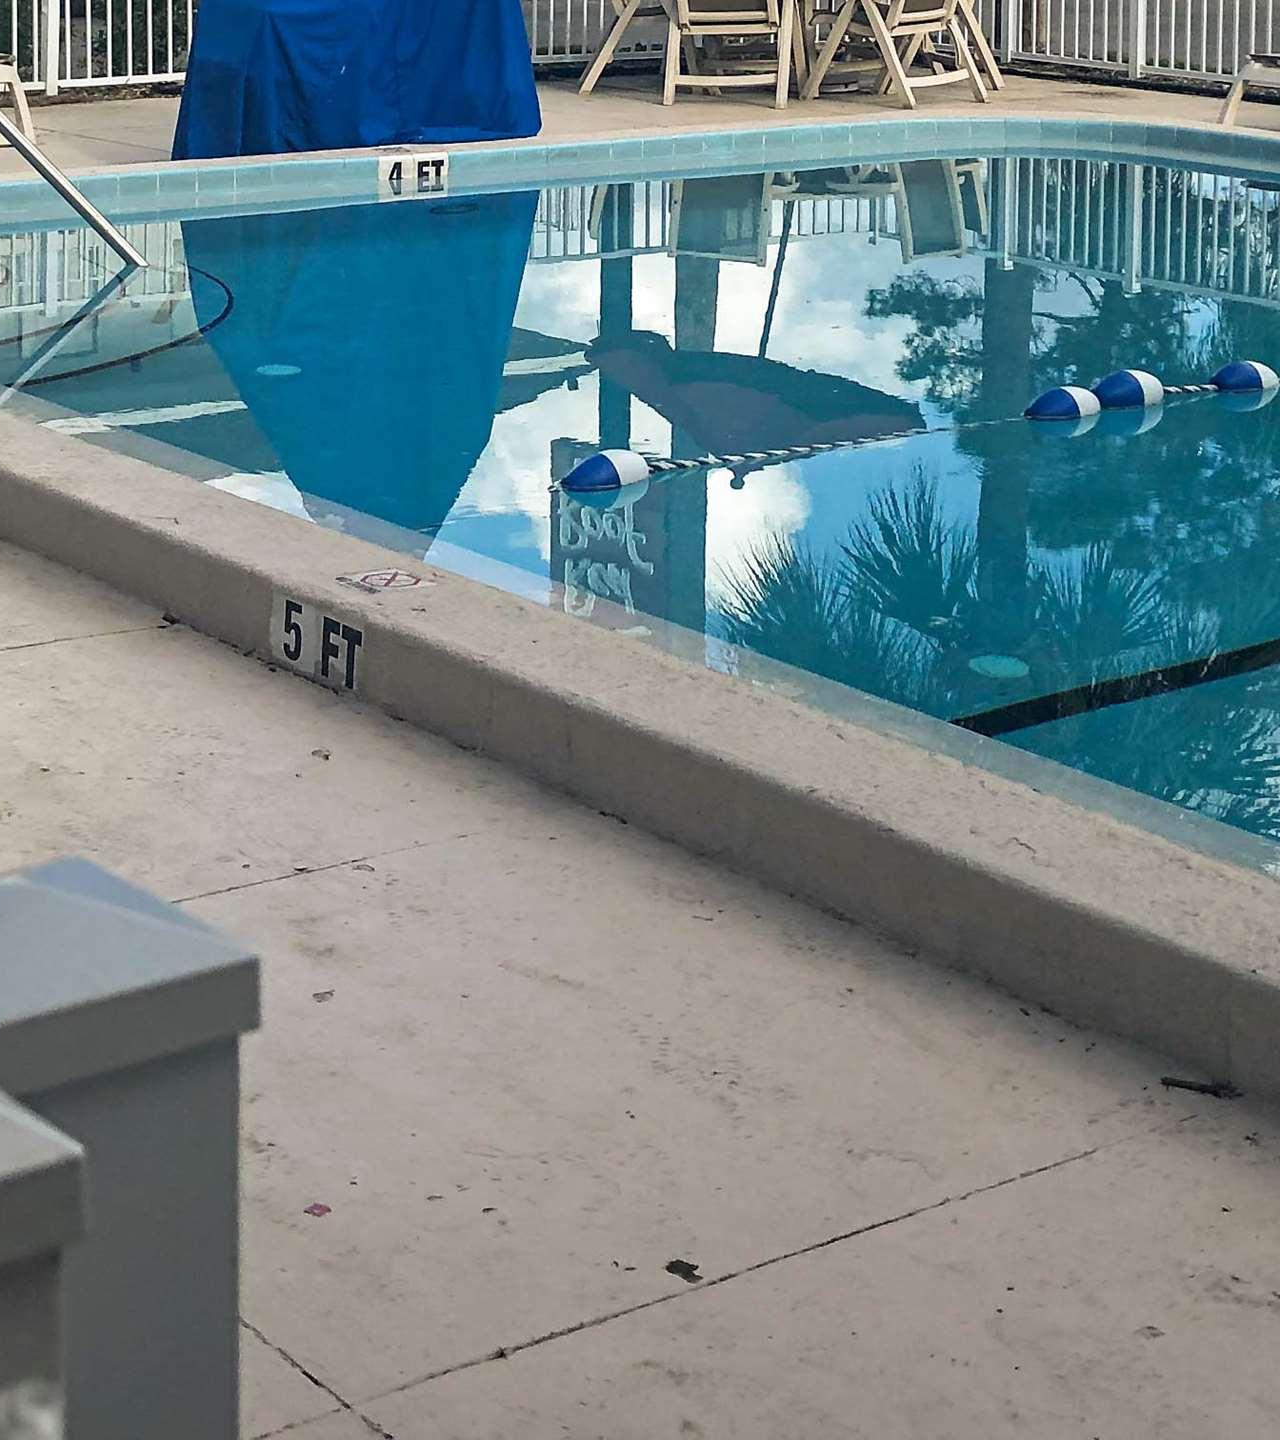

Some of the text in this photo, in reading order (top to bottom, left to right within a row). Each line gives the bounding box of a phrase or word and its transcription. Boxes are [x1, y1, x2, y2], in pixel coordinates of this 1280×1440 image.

[388, 161, 404, 183] 4
[283, 599, 363, 690] 5 FT
